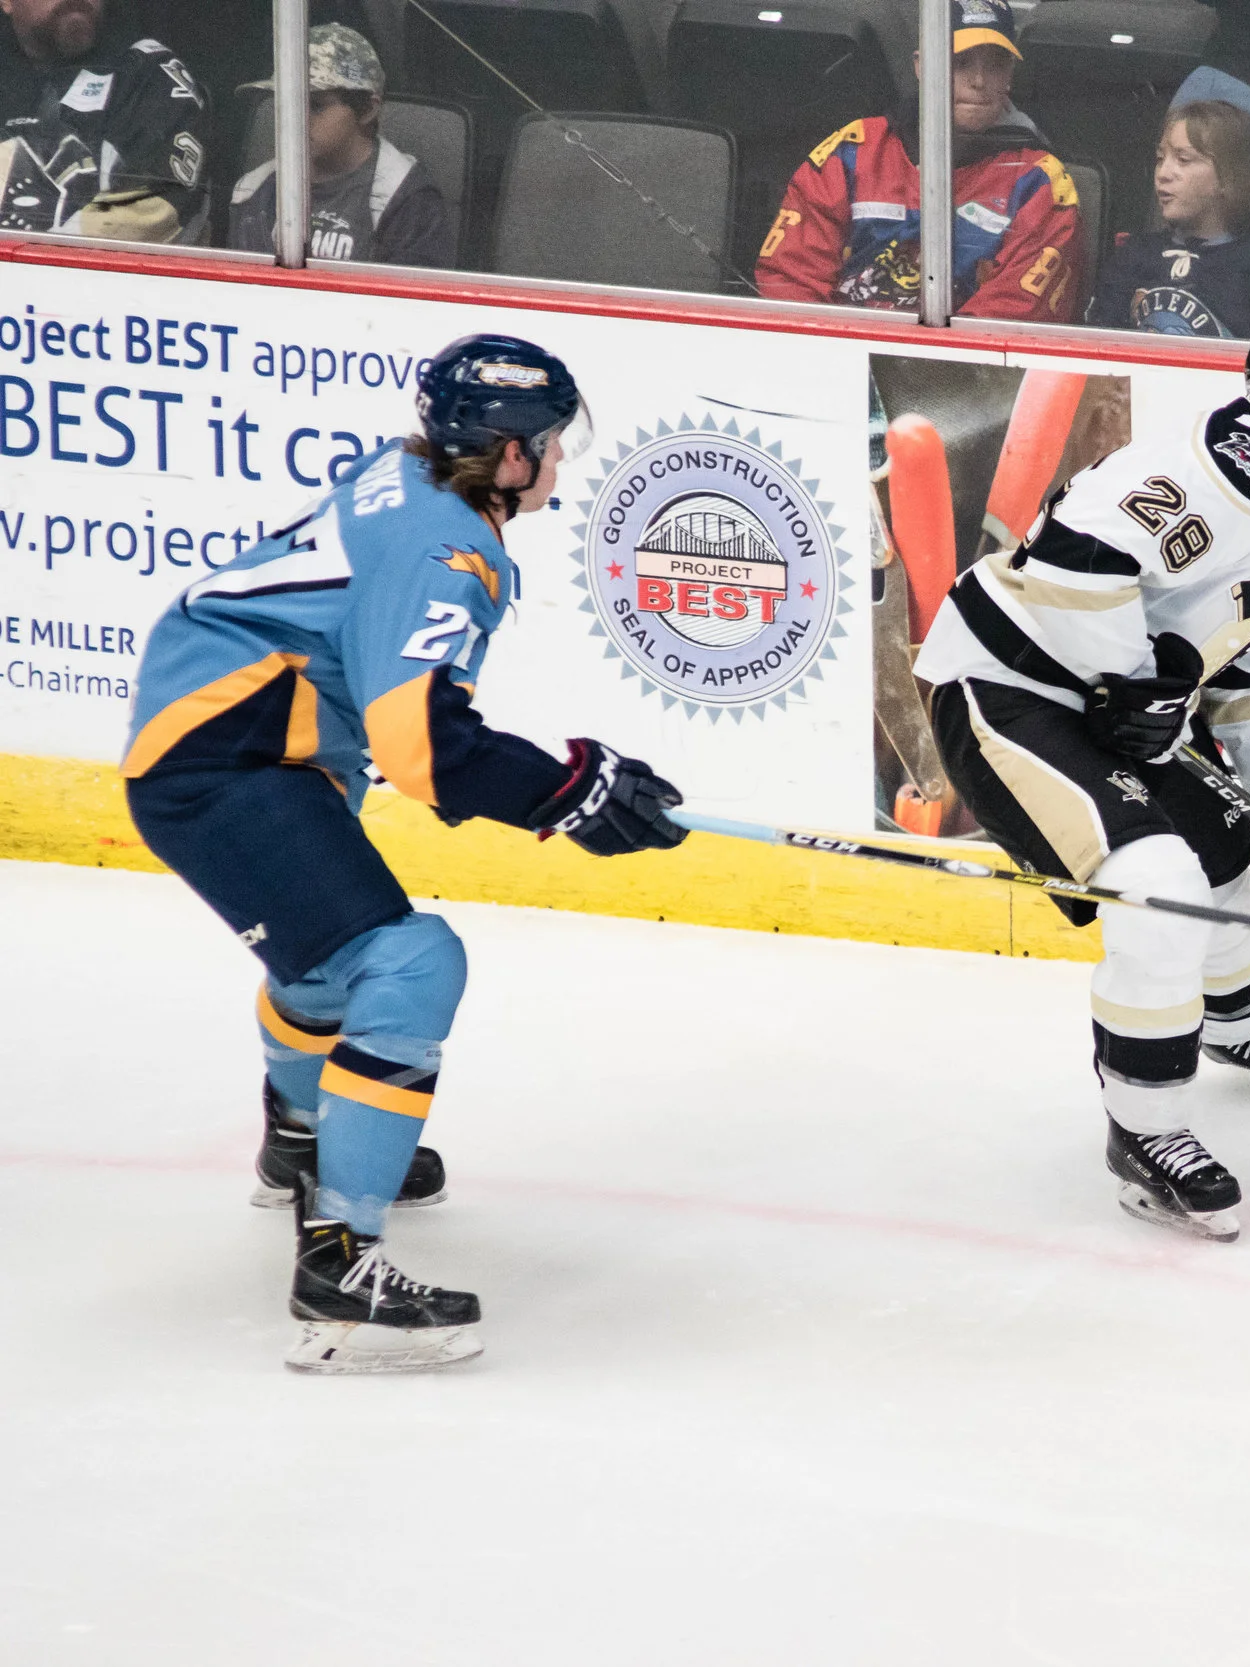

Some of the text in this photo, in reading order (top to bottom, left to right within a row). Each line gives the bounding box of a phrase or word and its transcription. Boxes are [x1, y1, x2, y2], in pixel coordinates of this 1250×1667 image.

[0, 304, 112, 365] oject
[125, 315, 239, 373] BEST
[1138, 292, 1210, 330] OLEDO
[0, 374, 386, 488] BEST it ca
[602, 450, 817, 559] GOOD CONSTRUCTION
[1118, 475, 1214, 574] 28
[669, 560, 753, 581] PROJECT
[636, 576, 787, 625] BEST
[31, 618, 137, 656] MILLER
[613, 597, 812, 687] SEAL OF APPROVAL
[787, 831, 861, 853] CCM
